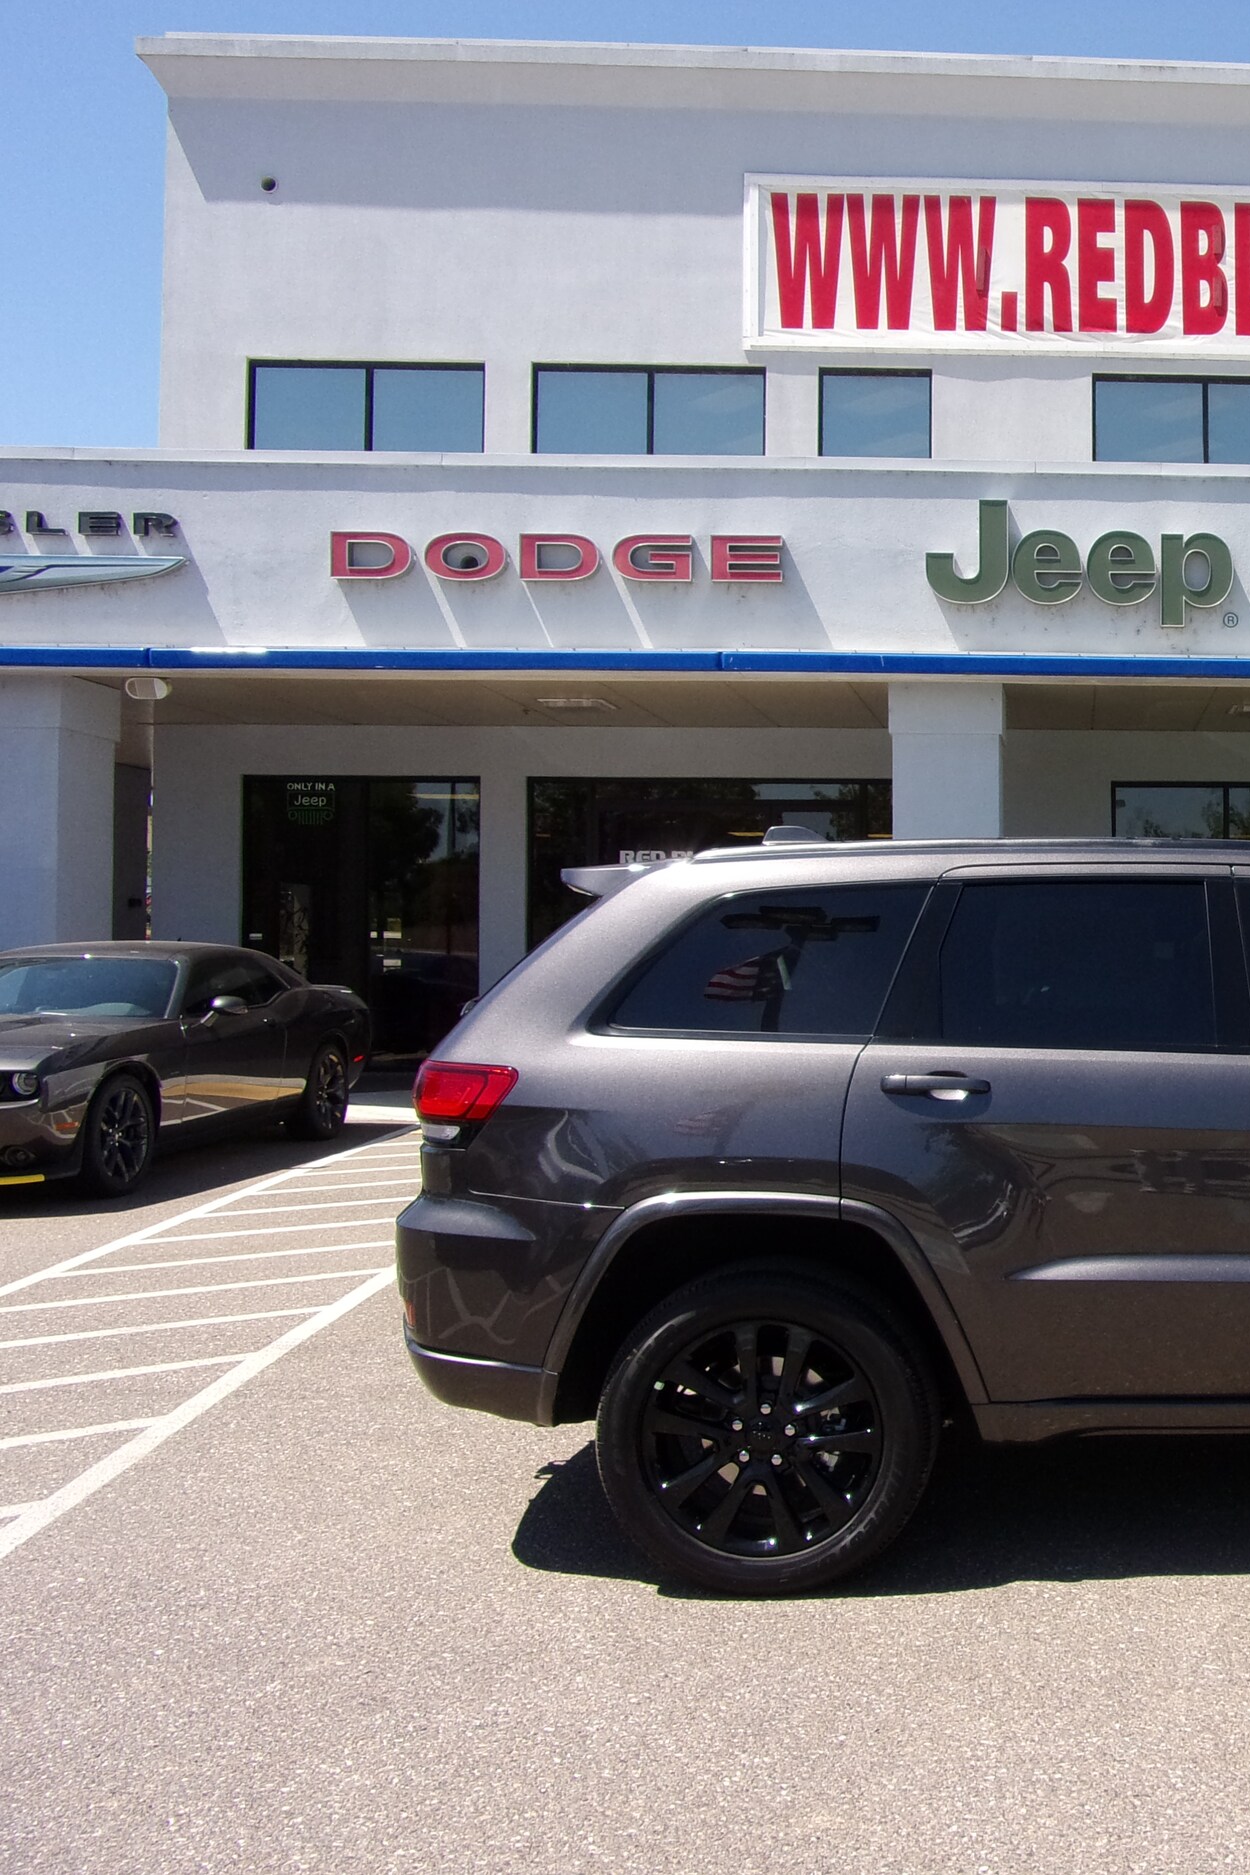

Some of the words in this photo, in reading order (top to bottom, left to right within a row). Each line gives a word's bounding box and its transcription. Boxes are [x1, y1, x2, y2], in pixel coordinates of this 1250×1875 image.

[330, 530, 784, 583] DODGE
[925, 499, 1235, 628] Jeep
[294, 795, 327, 807] Jeep
[328, 783, 336, 791] A
